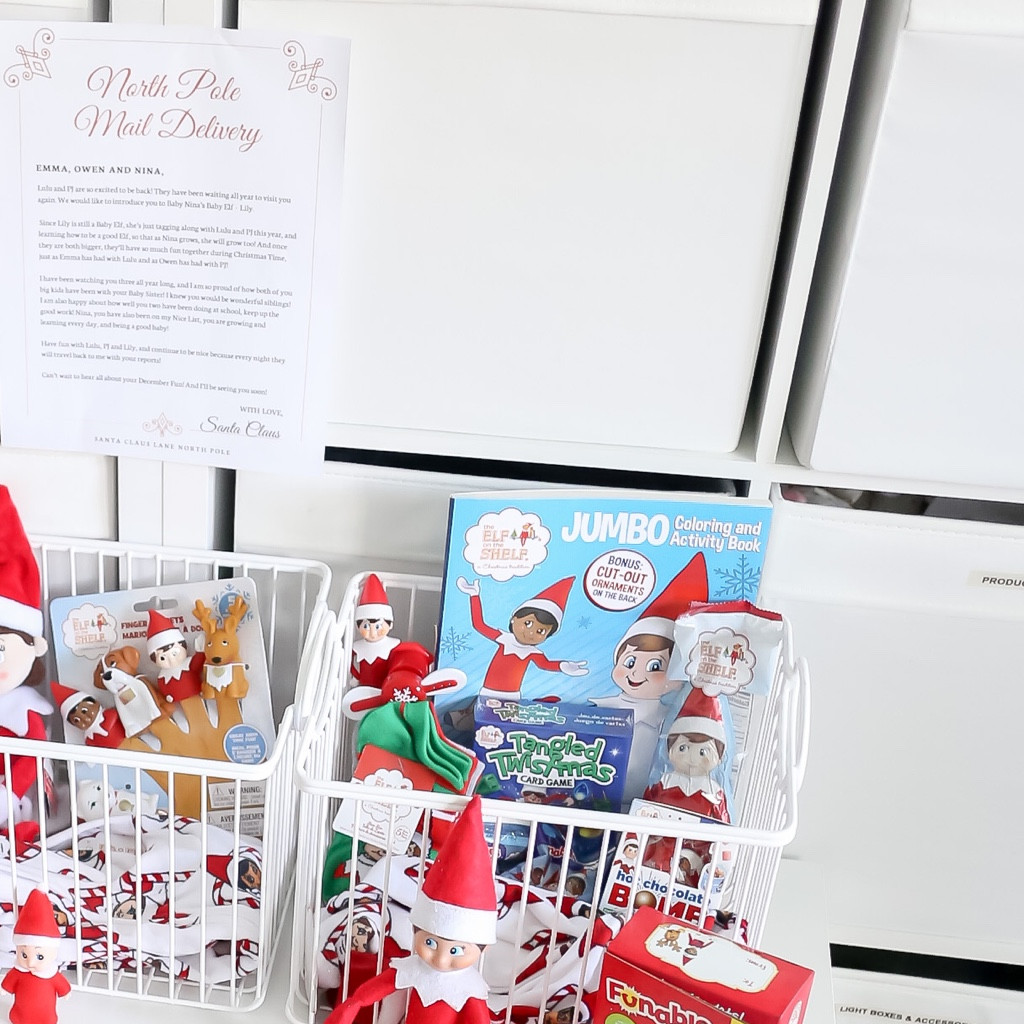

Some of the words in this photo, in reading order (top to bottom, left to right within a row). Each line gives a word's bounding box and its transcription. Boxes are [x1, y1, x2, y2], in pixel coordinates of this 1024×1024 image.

[87, 65, 169, 102] North
[176, 68, 241, 101] Pole
[74, 105, 154, 140] Mail
[158, 108, 263, 152] Delivery
[36, 165, 71, 173] EMMA,
[109, 166, 131, 174] AND
[134, 167, 164, 176] NINA,
[154, 188, 170, 196] They
[205, 191, 229, 199] waiting
[113, 198, 144, 206] introduce
[167, 200, 183, 208] Baby
[262, 408, 283, 417] LOVE,
[200, 416, 240, 434] Santa
[246, 421, 280, 438] Claus
[178, 445, 207, 453] NORTH
[561, 511, 670, 546] JUMBO
[674, 515, 732, 536] Coloring
[735, 521, 762, 536] and
[483, 530, 509, 542] ELF
[669, 531, 726, 553] Activity
[727, 537, 761, 552] Book
[480, 548, 528, 560] SHELF
[608, 554, 643, 571] BONUS:
[596, 566, 648, 585] CUT-OUT
[591, 578, 645, 597] ORNAMENTS
[592, 589, 602, 598] ON
[603, 590, 617, 601] THE
[618, 592, 637, 604] BACK
[121, 621, 147, 629] FINGER
[509, 733, 603, 760] Tangled
[520, 776, 544, 786] CARD
[546, 777, 573, 787] GAME
[840, 1006, 868, 1014] LIGHT
[870, 1009, 902, 1020] BOXES
